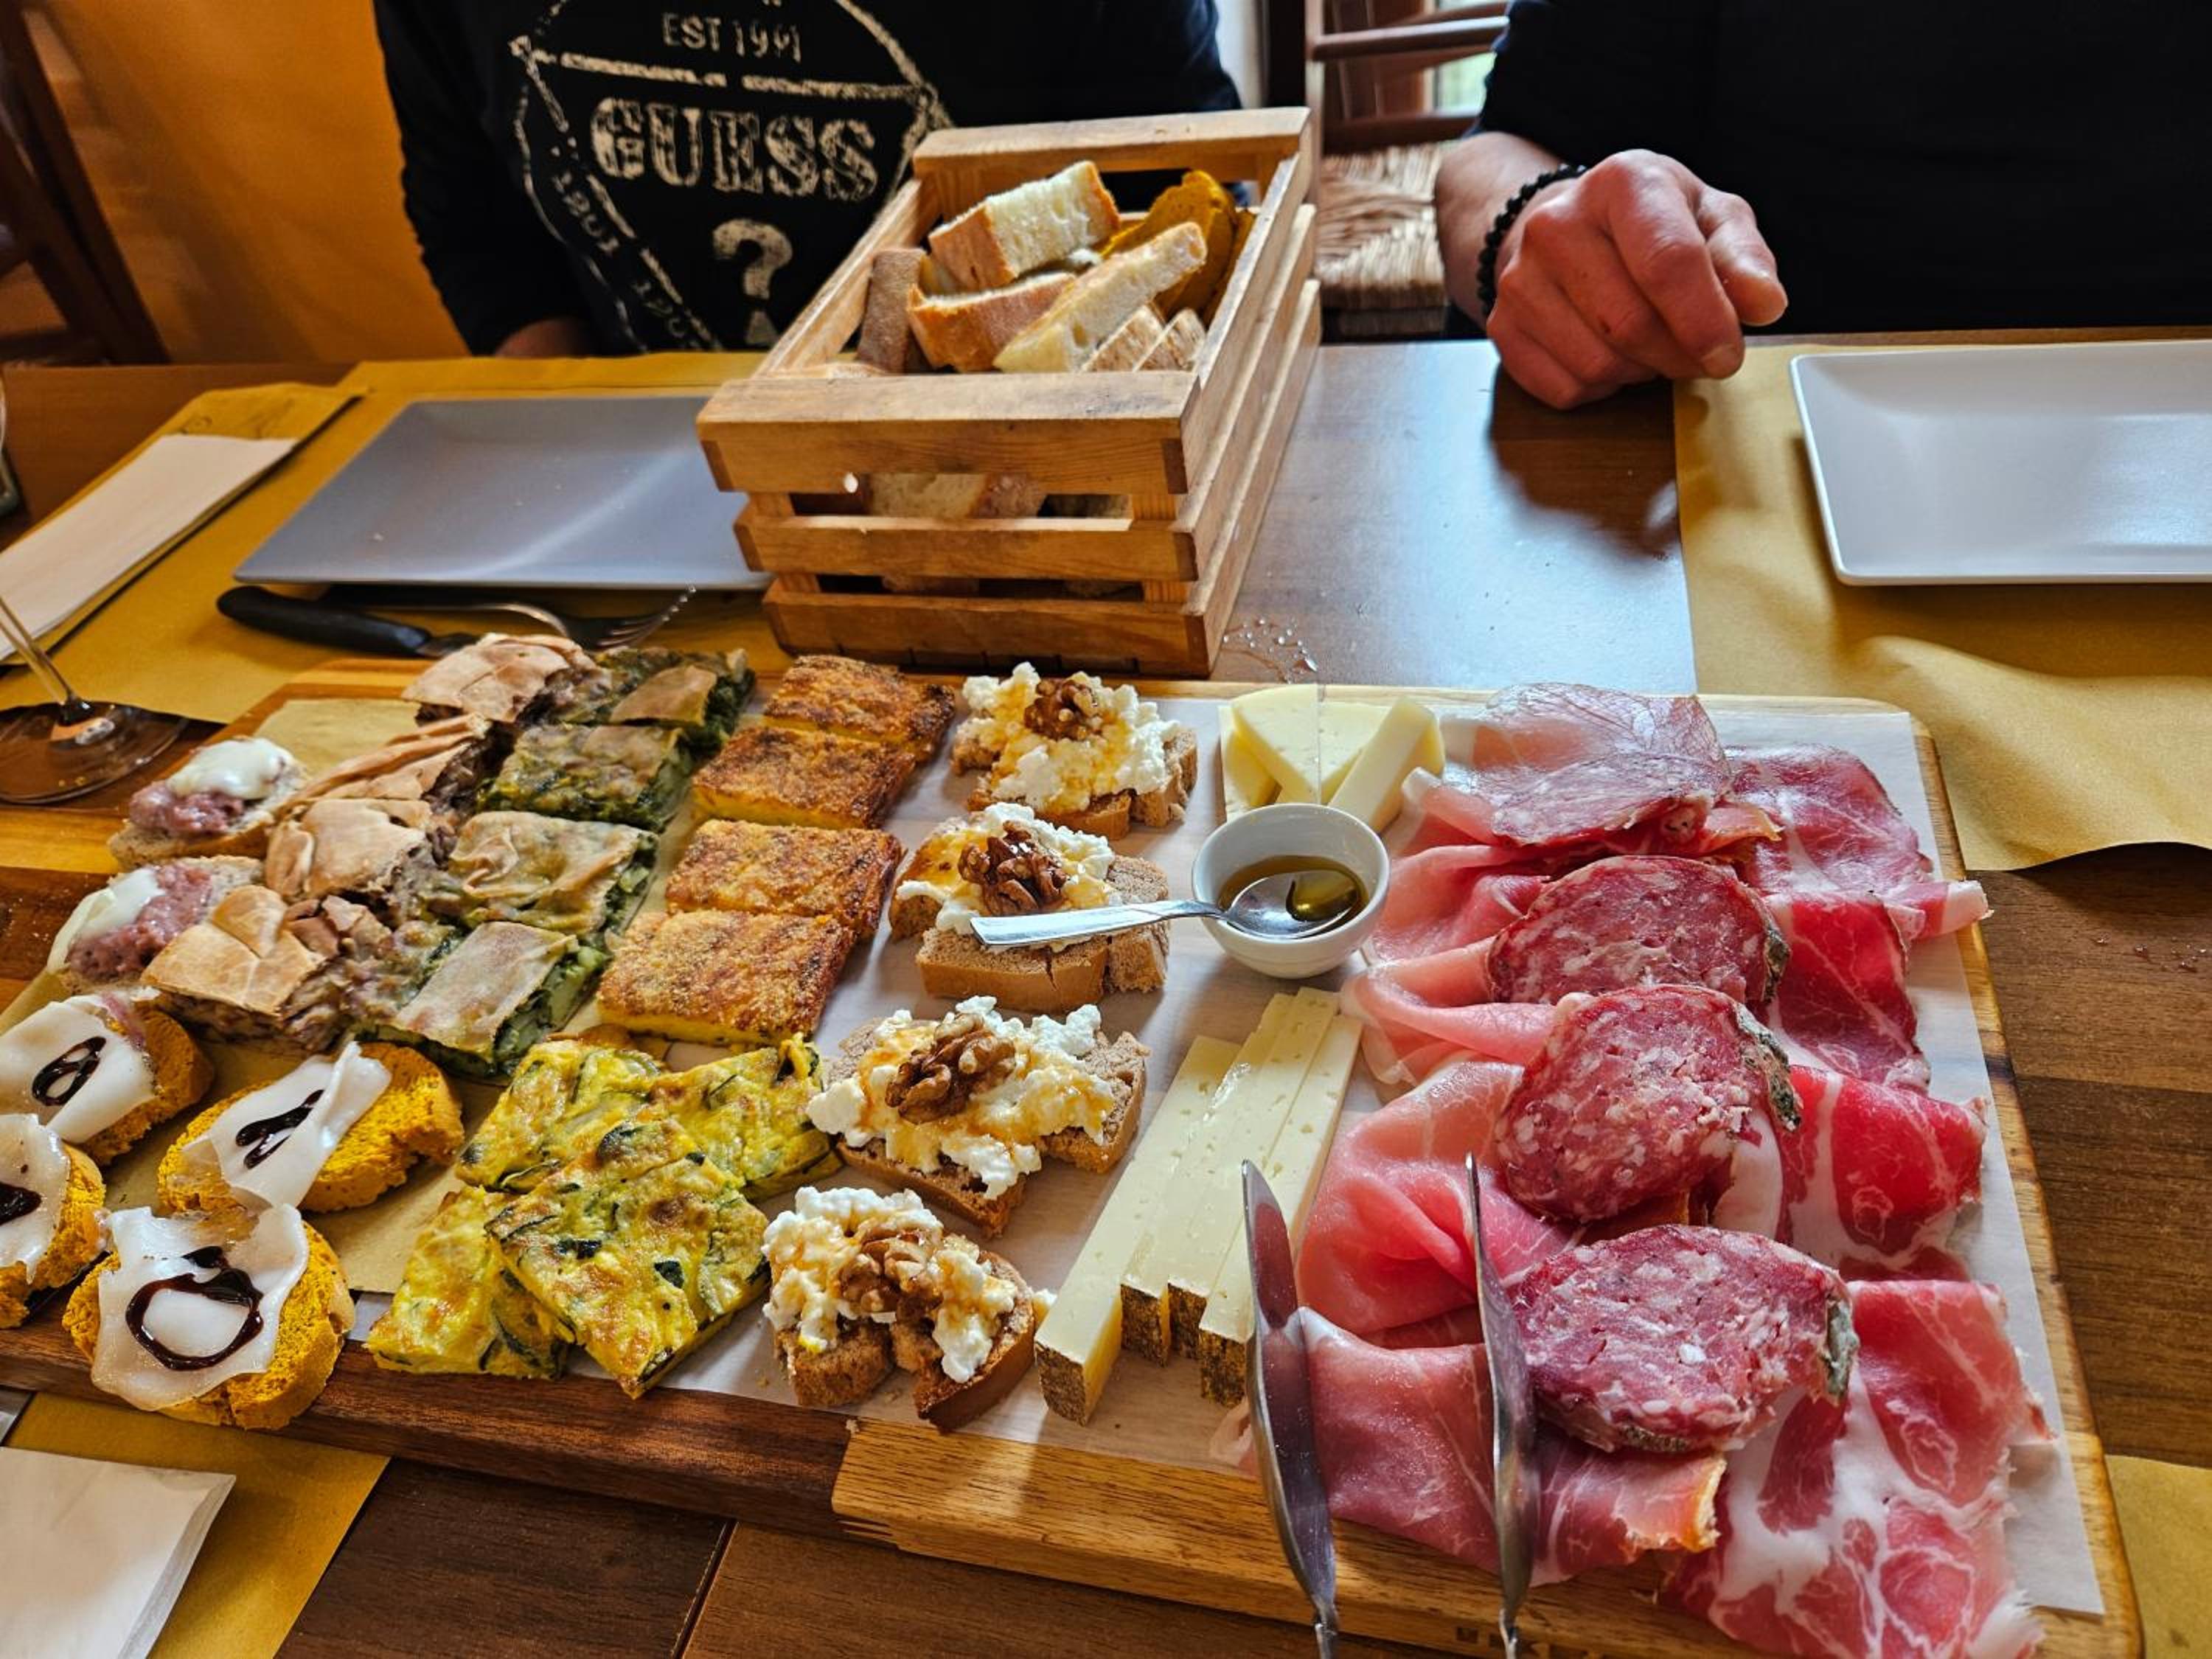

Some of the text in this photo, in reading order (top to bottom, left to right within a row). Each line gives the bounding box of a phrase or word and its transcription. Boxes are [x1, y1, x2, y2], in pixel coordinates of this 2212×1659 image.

[664, 13, 720, 50] EST
[591, 97, 878, 201] GUESS
[712, 219, 793, 346] ?
